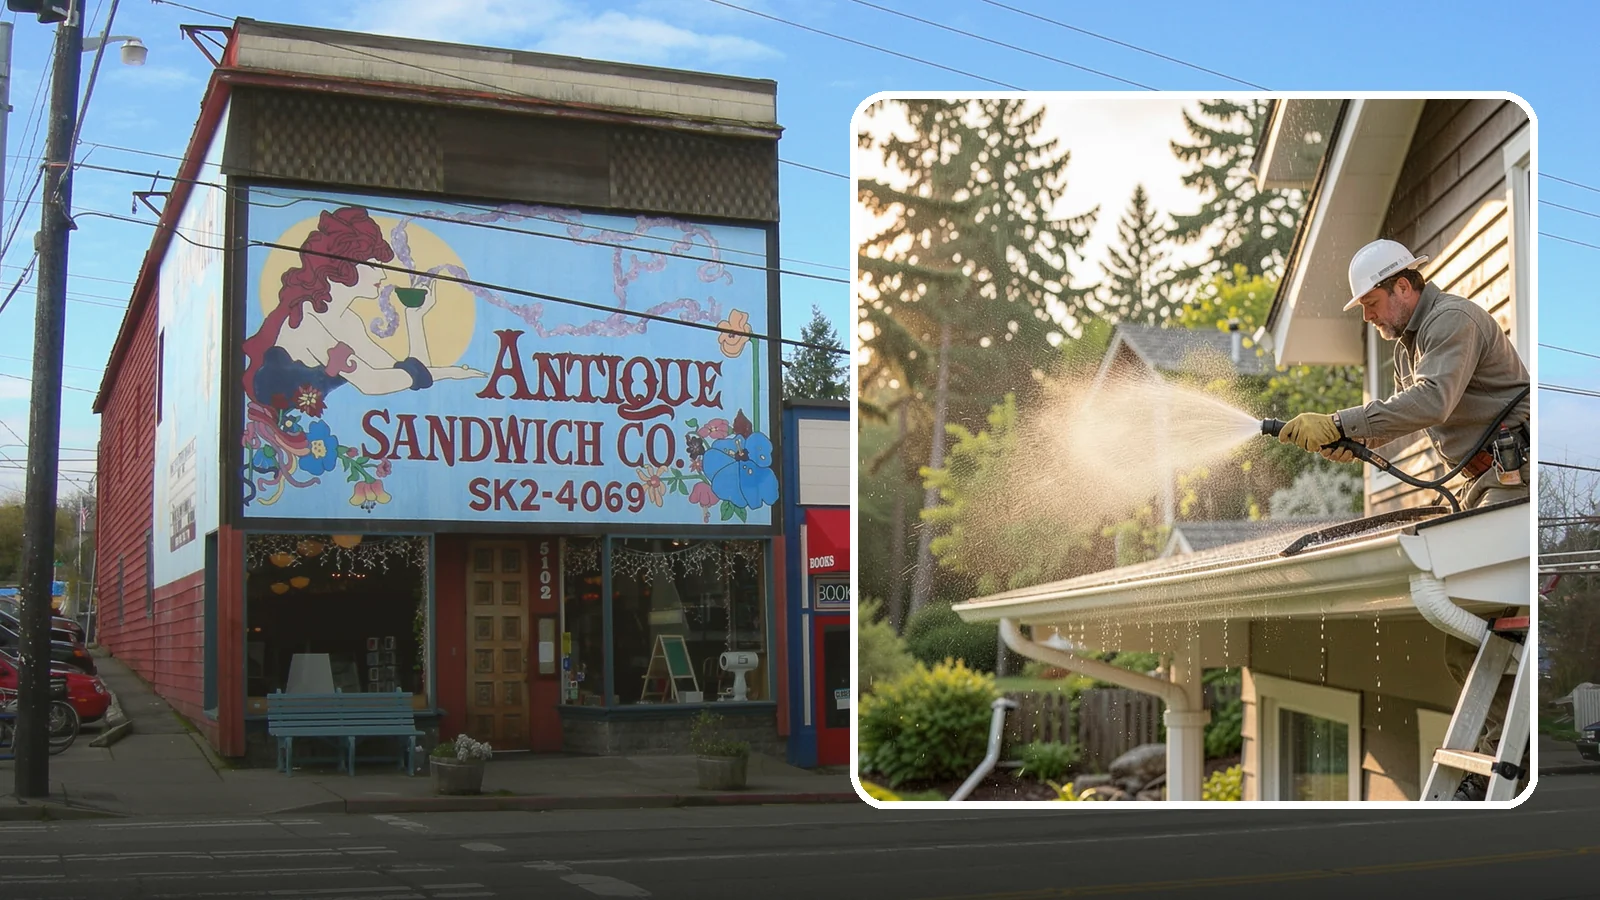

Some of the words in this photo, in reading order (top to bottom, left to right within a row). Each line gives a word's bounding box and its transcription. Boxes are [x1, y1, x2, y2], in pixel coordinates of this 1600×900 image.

[476, 329, 723, 421] ANTIQUE
[361, 409, 604, 467] SANDWICH
[617, 422, 685, 469] CO.
[469, 477, 645, 513] SK2-4069
[539, 541, 552, 600] 5102
[809, 555, 835, 569] BOOKS
